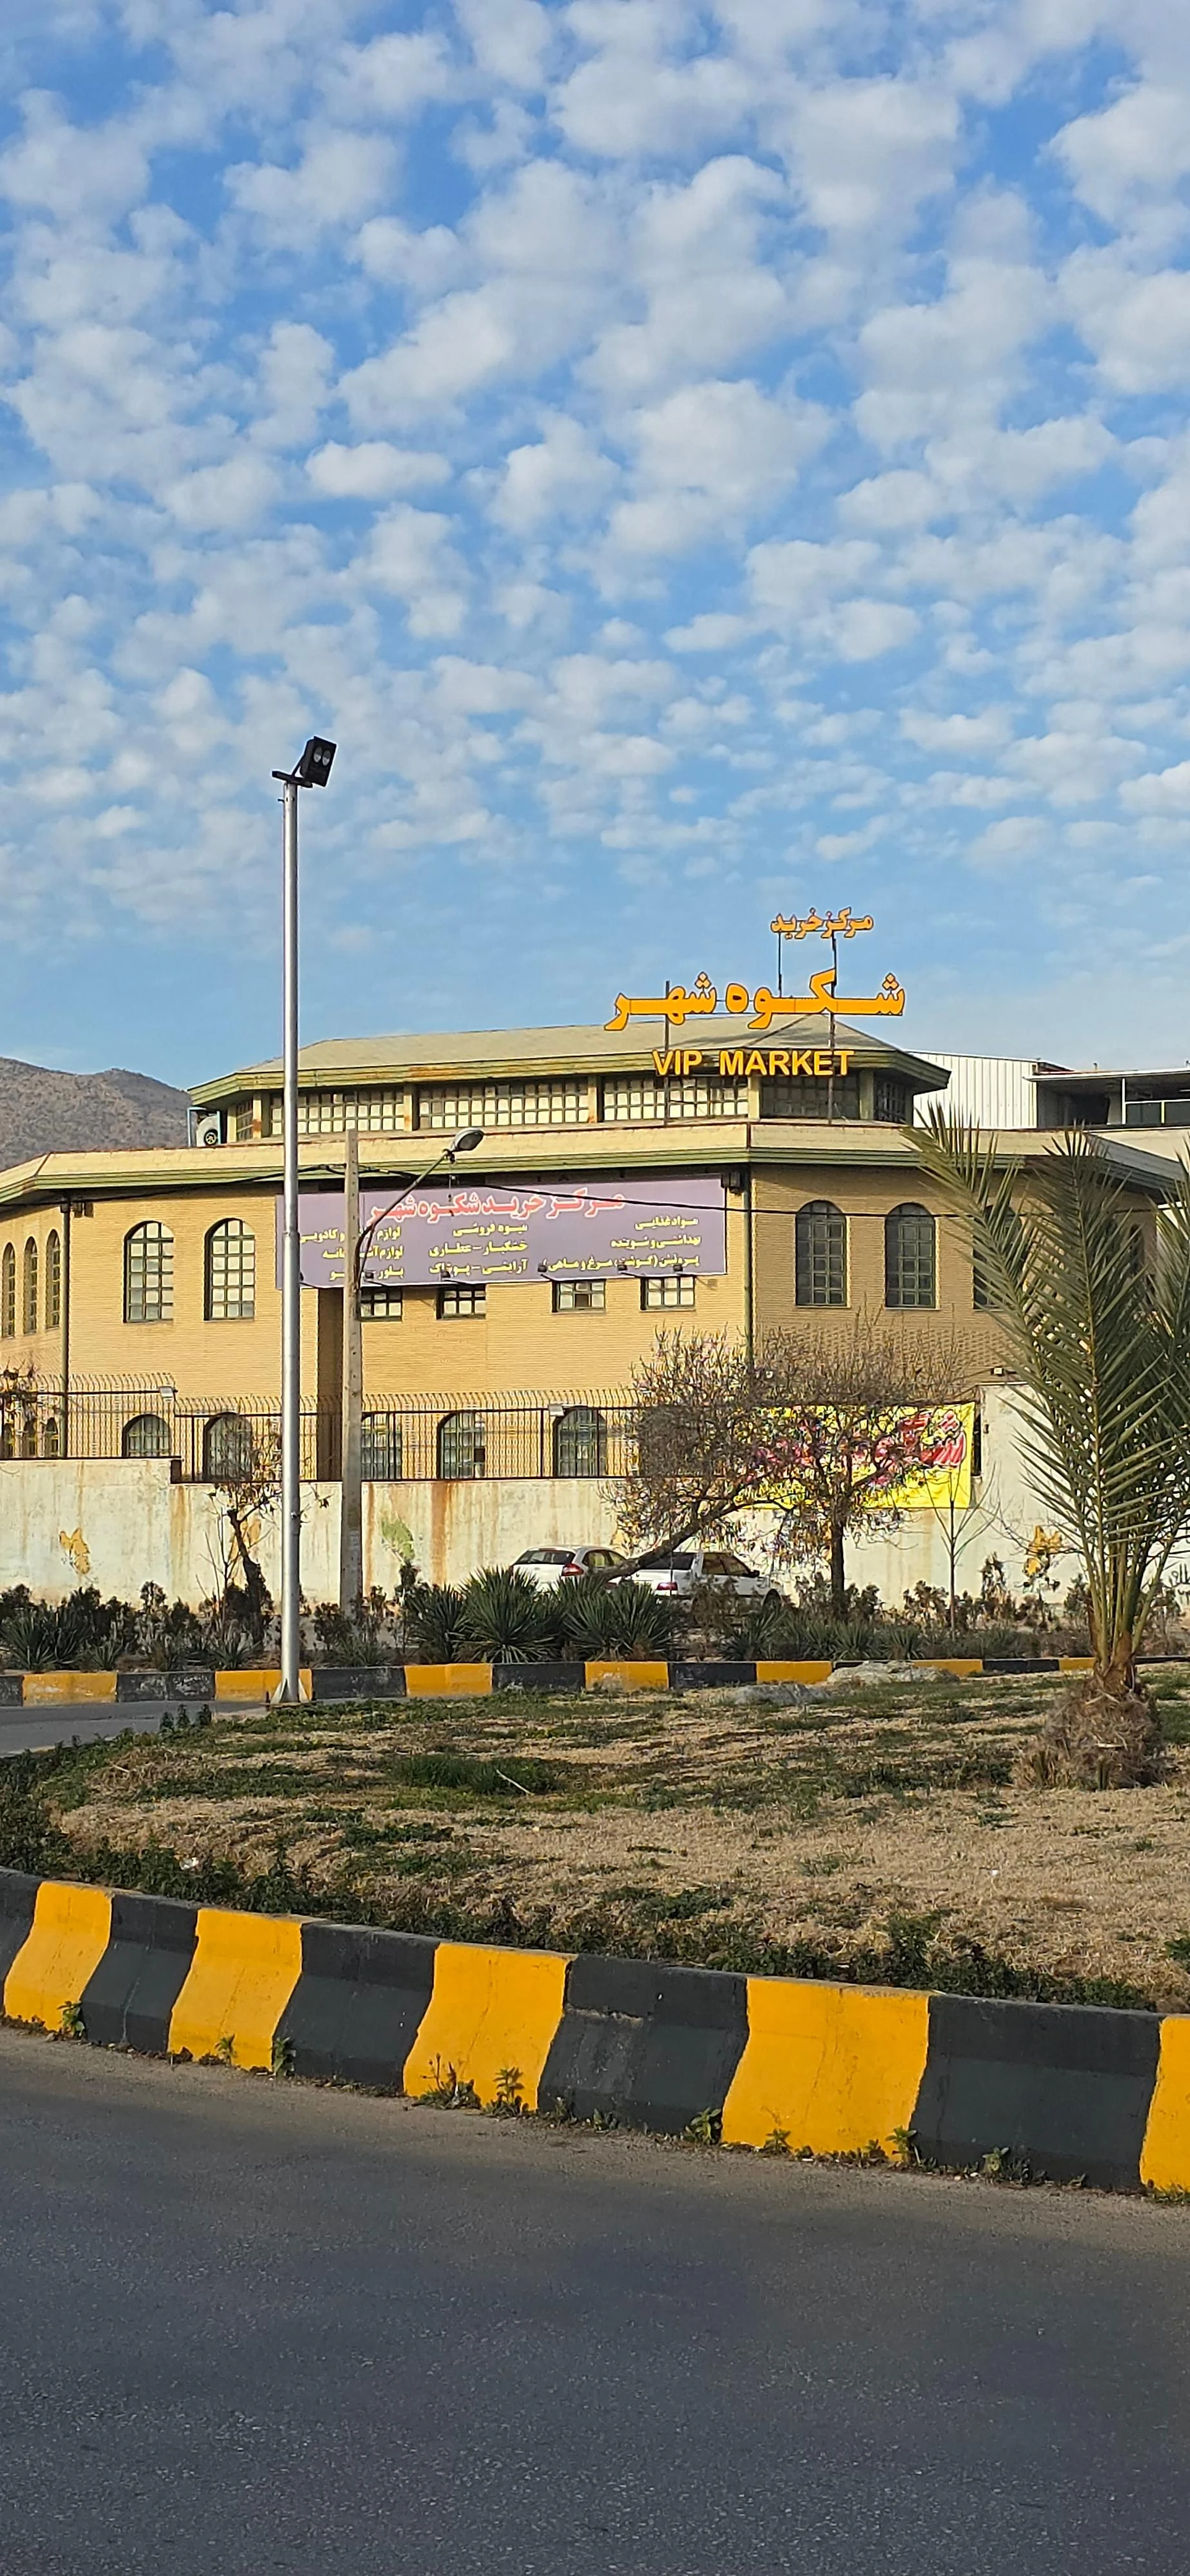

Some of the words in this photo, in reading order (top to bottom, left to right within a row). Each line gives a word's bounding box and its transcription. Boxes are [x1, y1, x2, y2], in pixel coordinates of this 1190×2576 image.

[771, 907, 824, 940] خرید
[820, 907, 874, 938] مرکز
[604, 971, 717, 1030] شهر
[725, 968, 905, 1029] شکوه
[652, 1050, 702, 1076] VIP
[719, 1049, 855, 1076] MARKET
[366, 1194, 417, 1226] شهر
[417, 1192, 482, 1224] شکوه
[453, 1222, 496, 1237] فروشی
[497, 1224, 528, 1236] میوه
[634, 1215, 670, 1230] غذایی
[671, 1215, 699, 1229] مواد
[377, 1226, 401, 1242] لوازم
[656, 1234, 701, 1249] بهداشتی
[379, 1244, 404, 1260] لوازم
[429, 1242, 472, 1257] عطاری
[483, 1240, 529, 1256] خشکبار
[482, 1258, 528, 1274] آرایشی
[587, 1256, 613, 1271] مرغ
[378, 1265, 404, 1280] بلور
